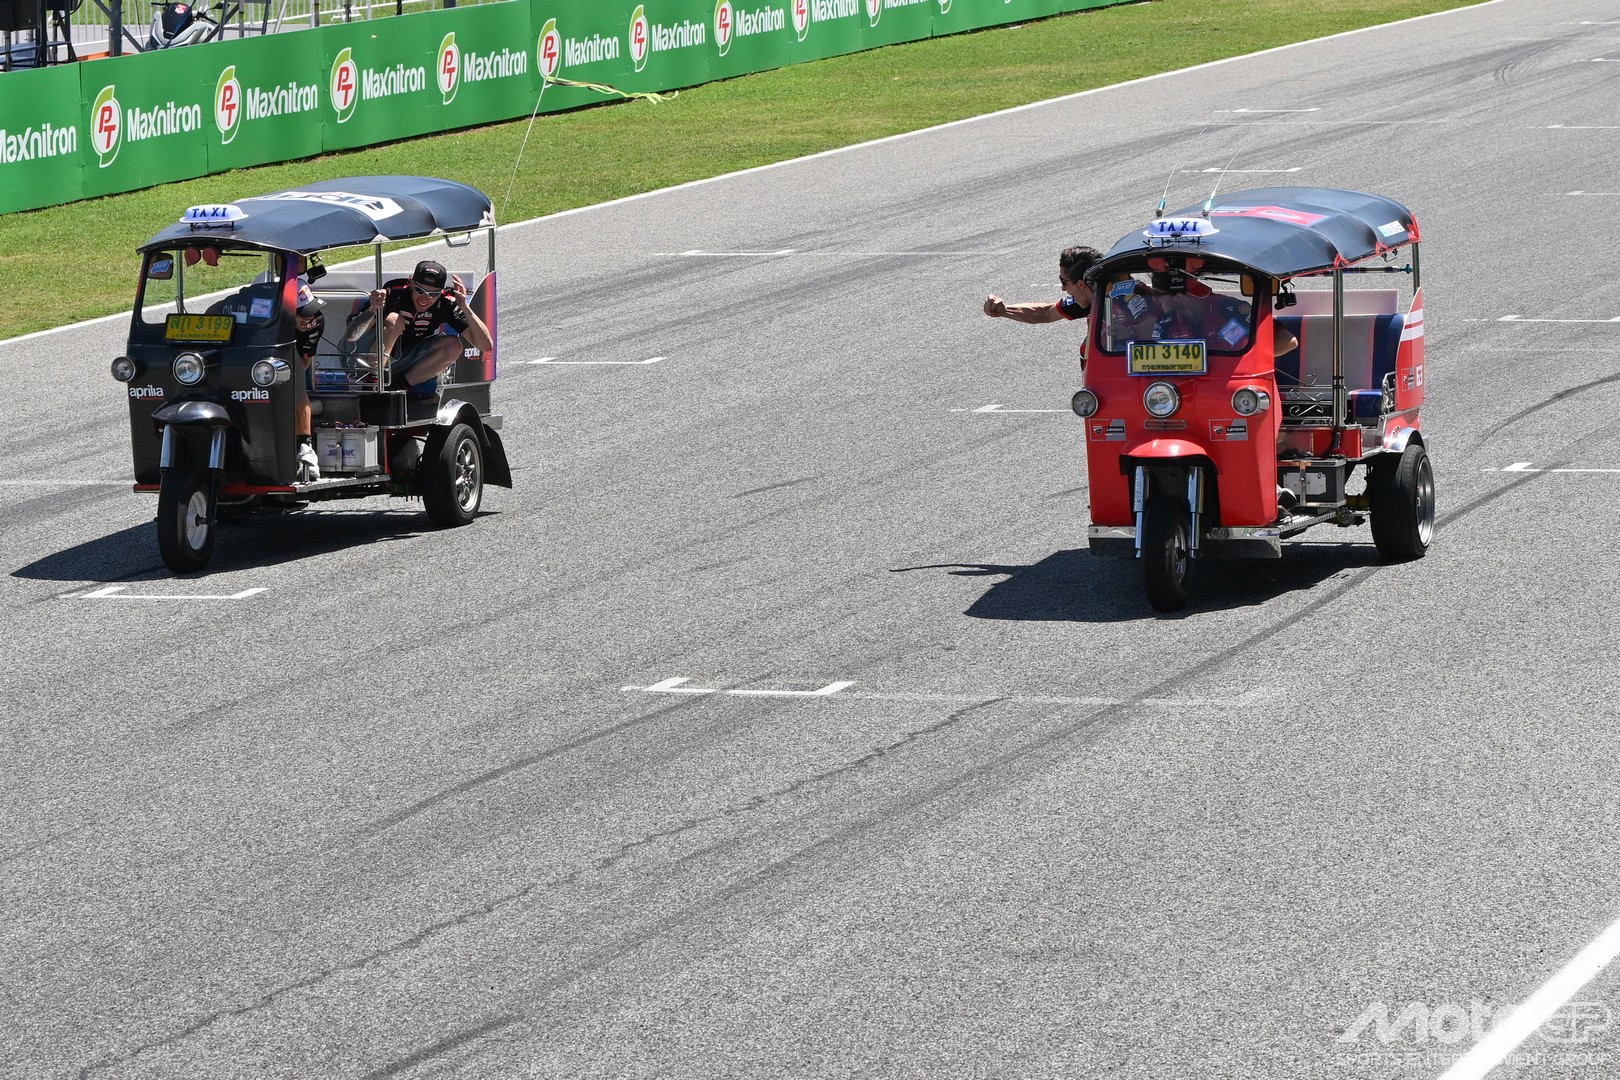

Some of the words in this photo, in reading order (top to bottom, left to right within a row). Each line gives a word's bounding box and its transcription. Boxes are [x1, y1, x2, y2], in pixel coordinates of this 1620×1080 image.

[652, 20, 706, 52] Maxnitron
[735, 6, 785, 37] Maxnitron
[463, 47, 527, 82] Maxnitron
[565, 33, 620, 67] Maxnitron
[362, 63, 426, 100] Maxnitron
[246, 82, 318, 120] Maxnitron
[127, 101, 201, 142] Maxnitron
[191, 207, 228, 218] TAXI
[1158, 220, 1199, 232] TAXI
[195, 316, 231, 330] 3199
[1161, 344, 1201, 360] 3140
[129, 384, 164, 399] aprilia
[231, 387, 269, 402] aprilia
